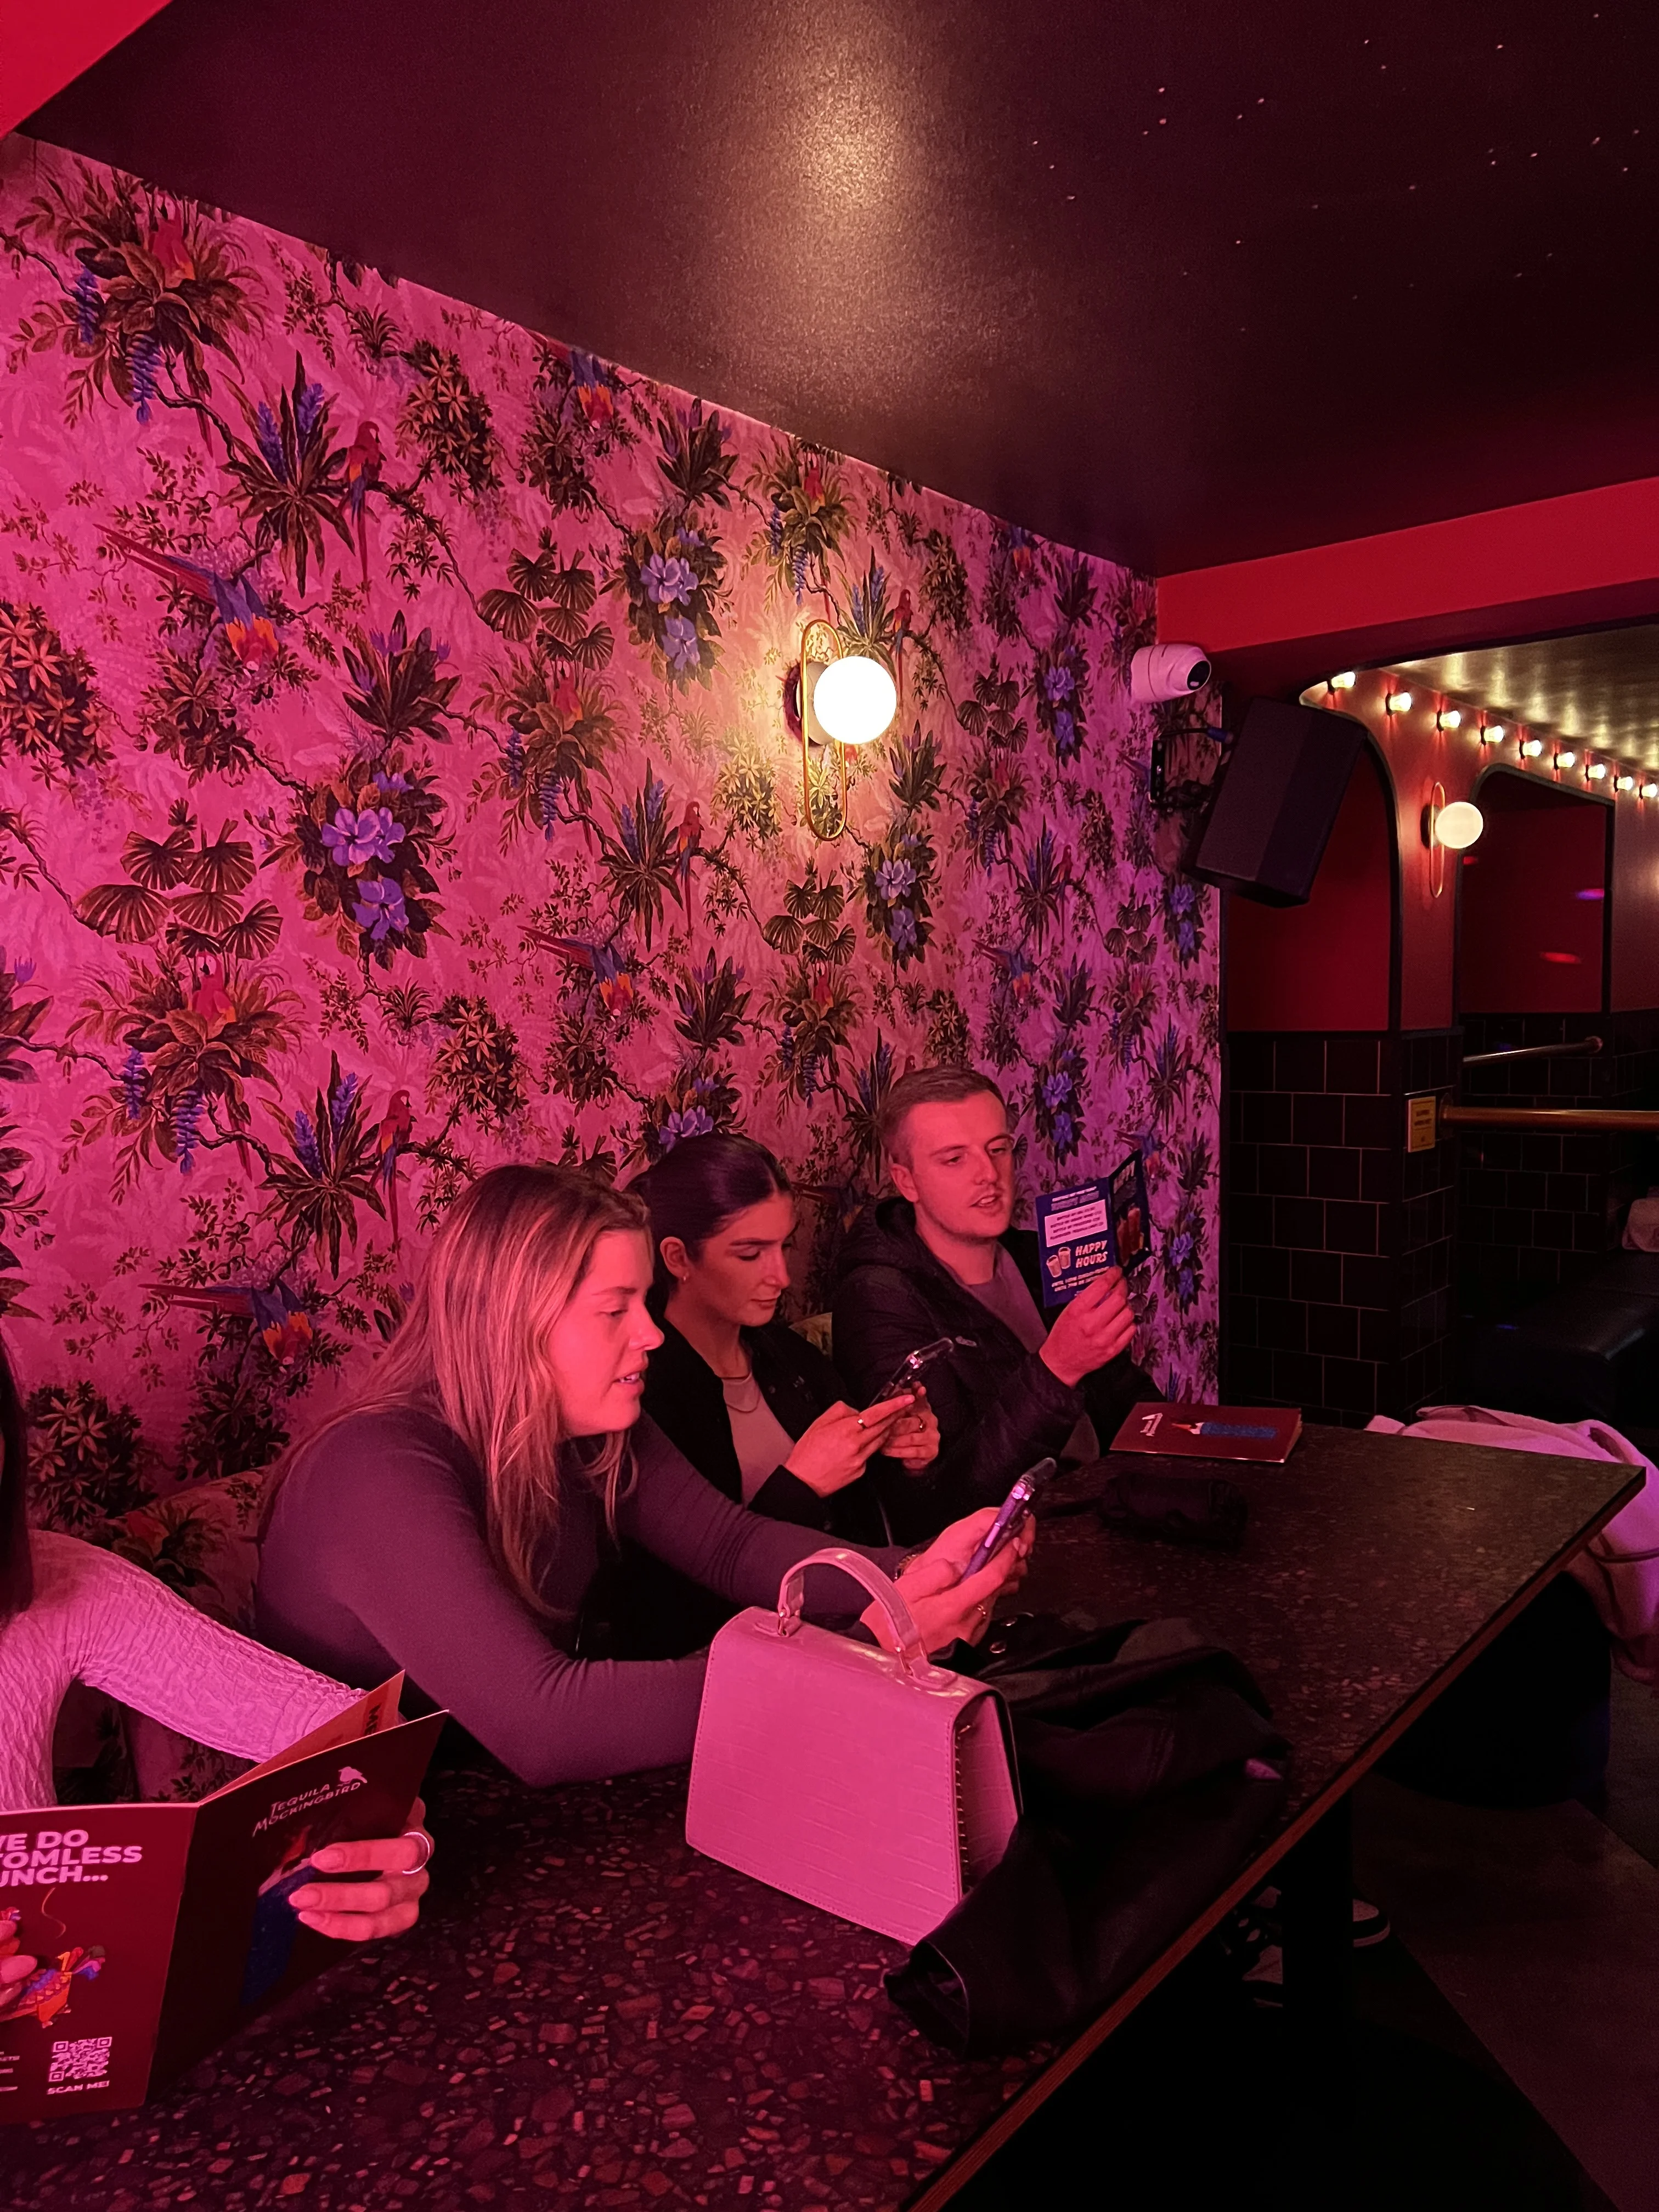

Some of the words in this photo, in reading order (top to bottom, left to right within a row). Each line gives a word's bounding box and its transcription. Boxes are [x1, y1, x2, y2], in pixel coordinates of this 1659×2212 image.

[1075, 1240, 1108, 1256] HAPPY
[1075, 1251, 1108, 1268] HOURS
[252, 1782, 361, 1838] MOCKINGBIRD
[270, 1784, 330, 1818] TEQUILA
[37, 1830, 89, 1849] DO
[0, 1846, 143, 1869] OMLESS
[47, 2084, 83, 2095] SCAN
